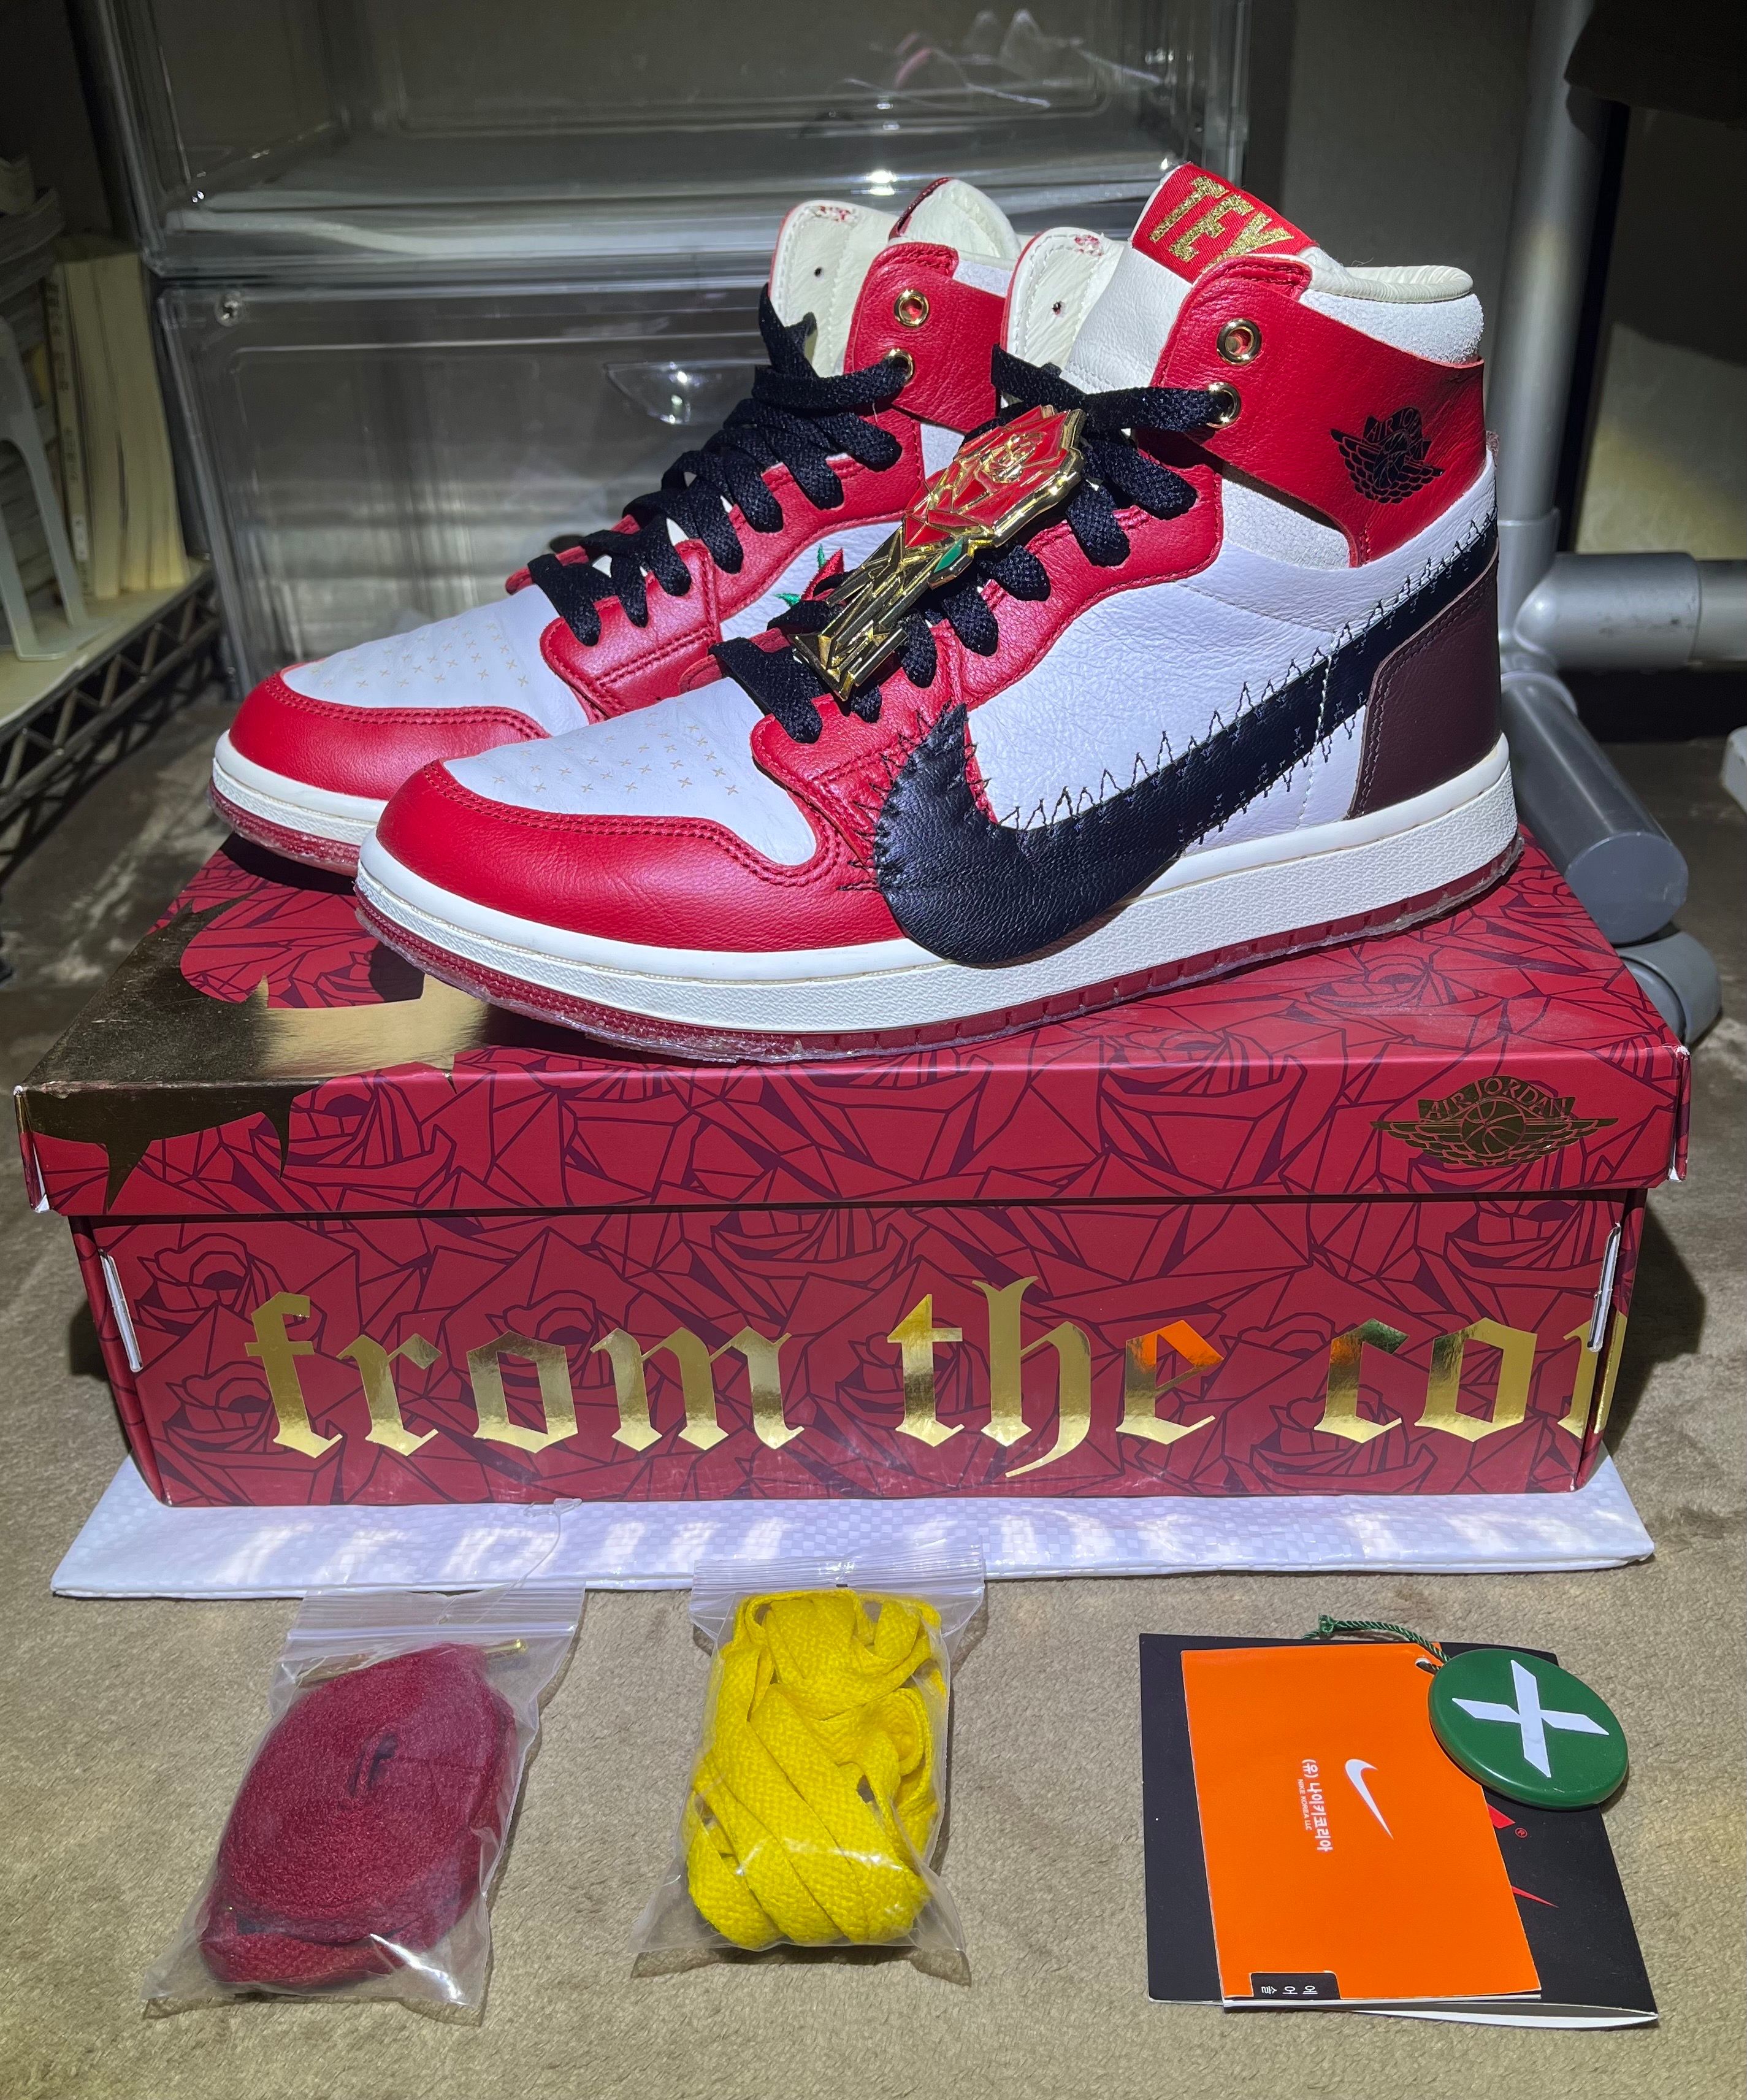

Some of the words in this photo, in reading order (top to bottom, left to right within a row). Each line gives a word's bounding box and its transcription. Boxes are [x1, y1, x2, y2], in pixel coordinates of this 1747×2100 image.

[1148, 175, 1294, 274] TEY
[1366, 417, 1394, 443] AIR
[1425, 1094, 1472, 1119] AIR
[1473, 1077, 1568, 1118] JORDAN
[245, 1291, 805, 1458] from
[886, 1276, 1225, 1478] the
[1301, 1796, 1310, 1819] KOREA
[1307, 1782, 1333, 1852] 나이키코리아
